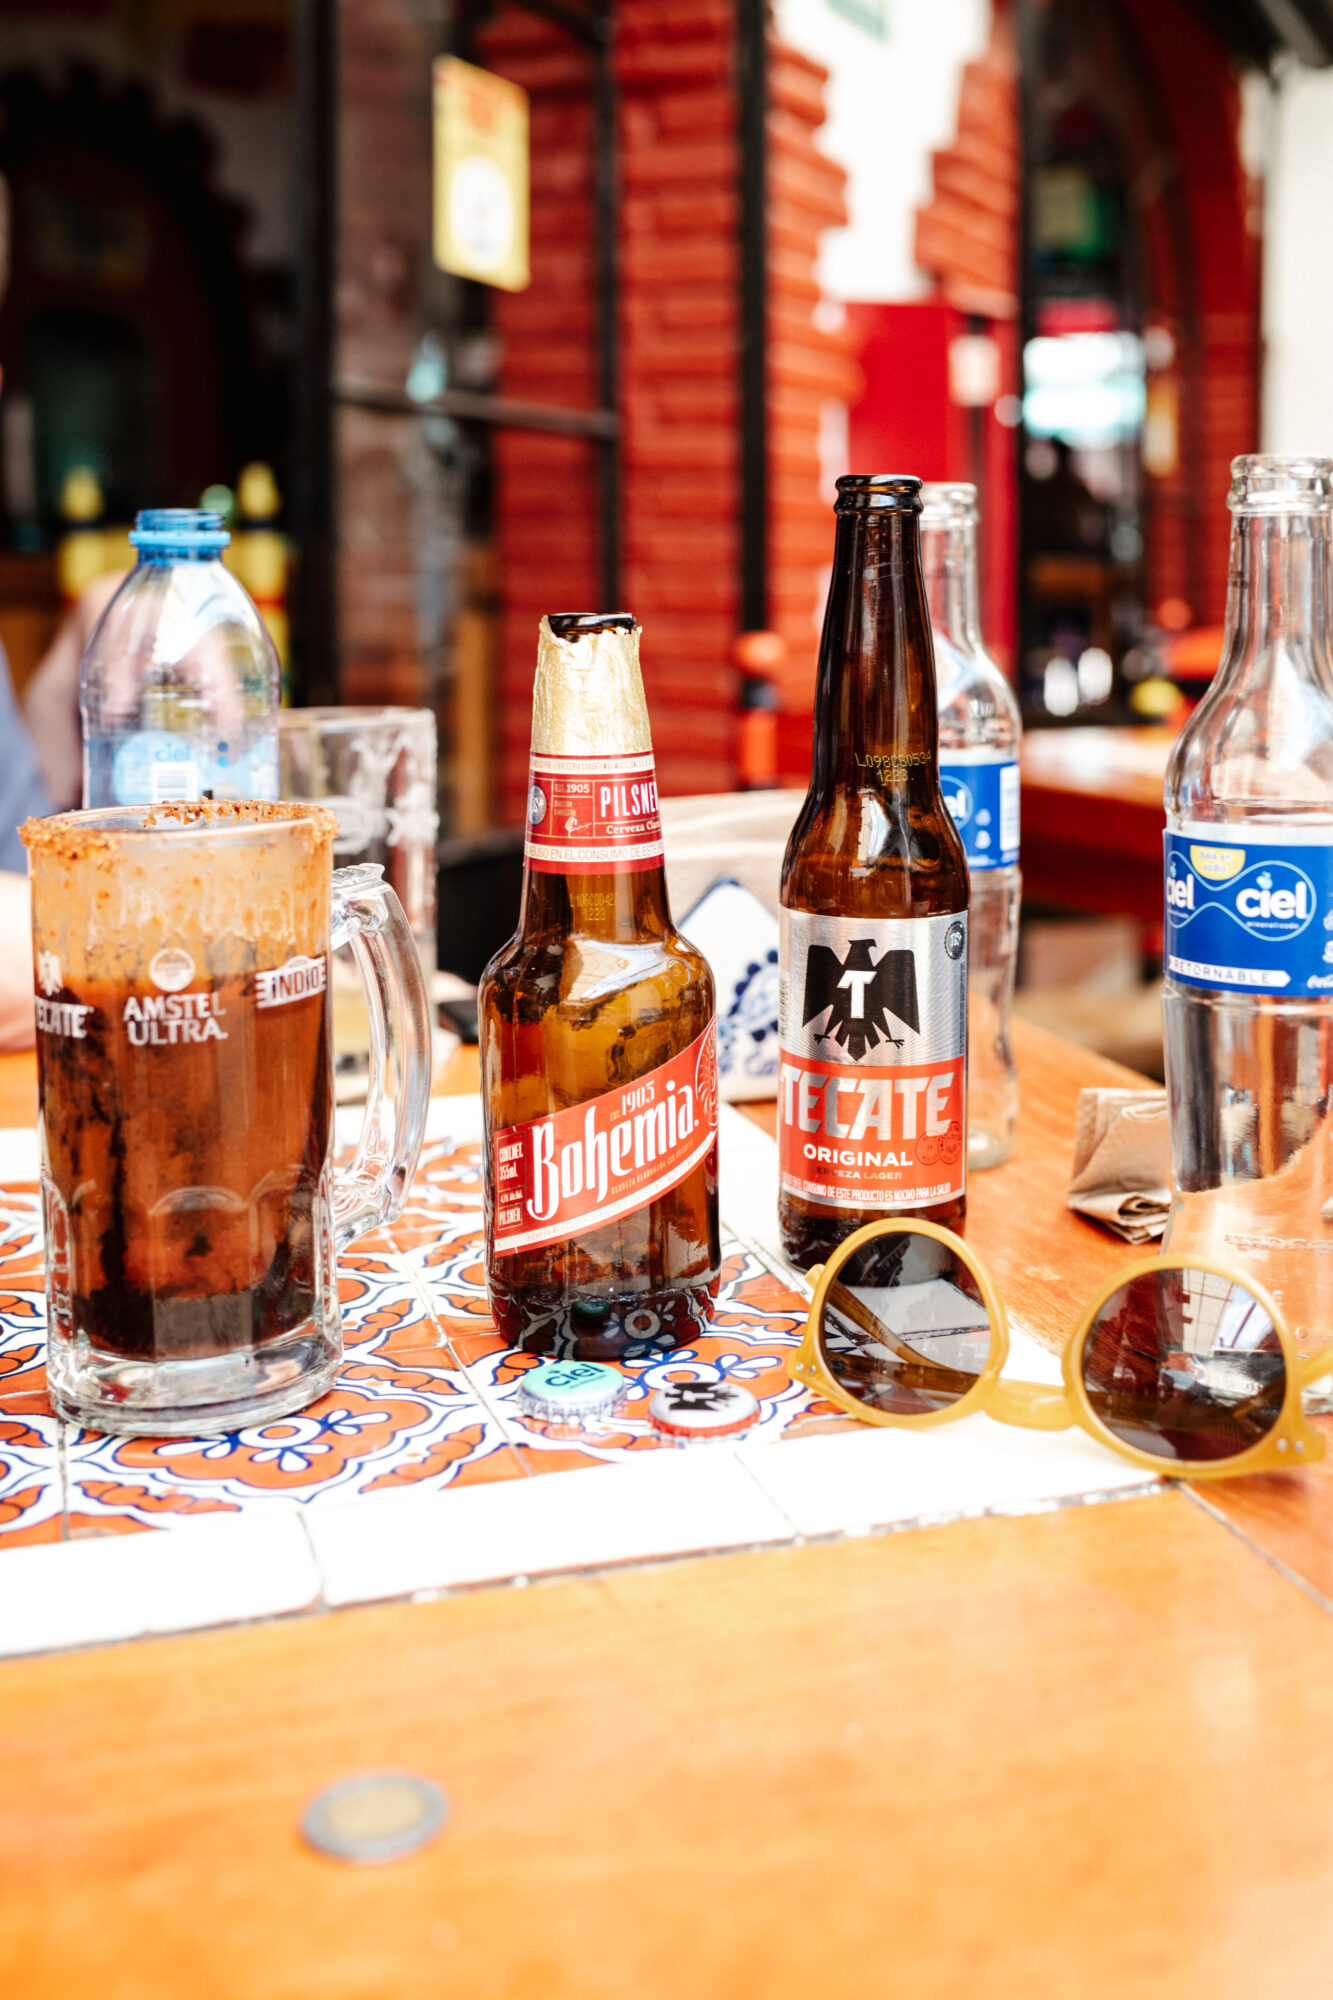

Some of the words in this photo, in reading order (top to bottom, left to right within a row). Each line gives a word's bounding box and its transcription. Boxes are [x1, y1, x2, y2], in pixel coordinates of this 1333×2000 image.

[154, 742, 191, 762] ciel
[566, 784, 590, 794] 1905
[606, 823, 645, 835] Cerveza
[564, 849, 576, 861] EL
[578, 848, 629, 860] CONSUMO
[631, 846, 641, 858] DE
[1236, 872, 1308, 920] ciel
[1174, 958, 1271, 985] RETORNABLE
[836, 969, 878, 1019] T
[124, 993, 226, 1021] AMSTEL
[622, 1080, 656, 1117] 1905
[781, 1062, 955, 1141] TECATE
[803, 1143, 913, 1167] ORIGINAL
[810, 1165, 861, 1179] CERVEZA
[863, 1171, 903, 1180] LAGER
[802, 1180, 827, 1197] CONSUMO
[828, 1186, 836, 1198] DE
[836, 1187, 851, 1200] ESTE
[852, 1189, 884, 1201] PRODUCTO
[885, 1190, 893, 1201] ES
[916, 1186, 929, 1199] PARA
[930, 1185, 936, 1197] LA
[937, 1181, 951, 1196] SALUD
[545, 1363, 606, 1387] ciel
